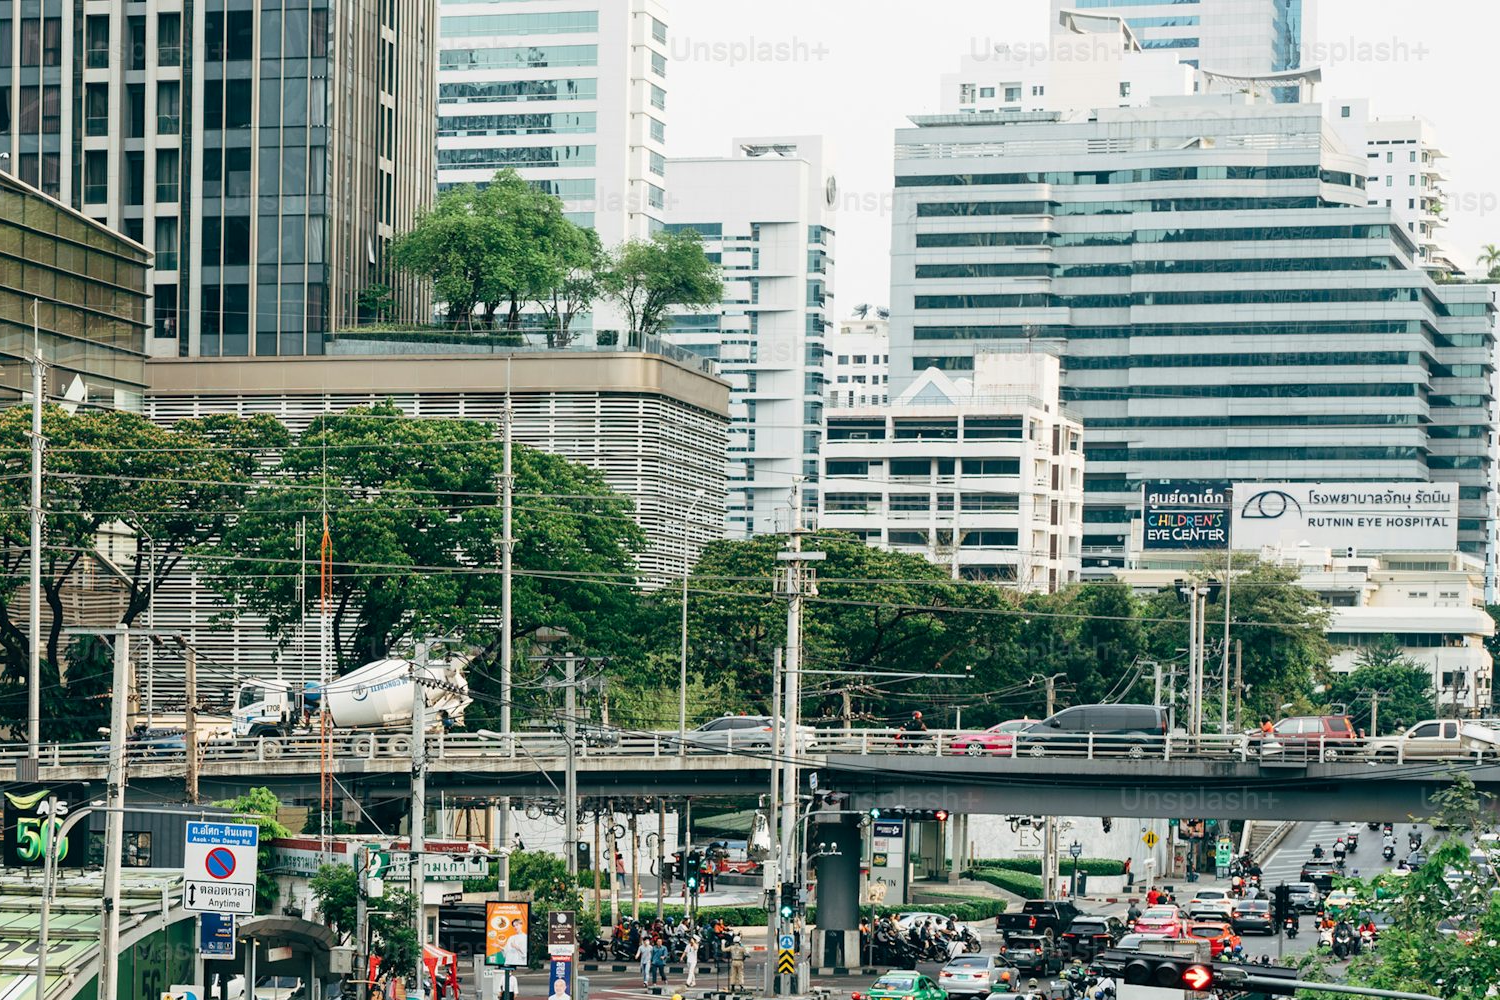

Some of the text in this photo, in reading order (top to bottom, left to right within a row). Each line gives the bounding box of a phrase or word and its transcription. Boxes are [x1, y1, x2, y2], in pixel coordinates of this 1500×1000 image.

[1149, 490, 1224, 509] ศูนย์ตาเด็ก
[1308, 489, 1451, 508] โรงพยาบาลจักษุ รัตนิน
[1148, 513, 1223, 528] CHILDREN'S
[1308, 518, 1449, 527] RUTNIN EYE HOSPITAL
[1148, 529, 1224, 542] EYE CENTER
[17, 817, 69, 861] 5G
[200, 885, 251, 897] ตลอดเวลา
[208, 898, 240, 908] Anytime
